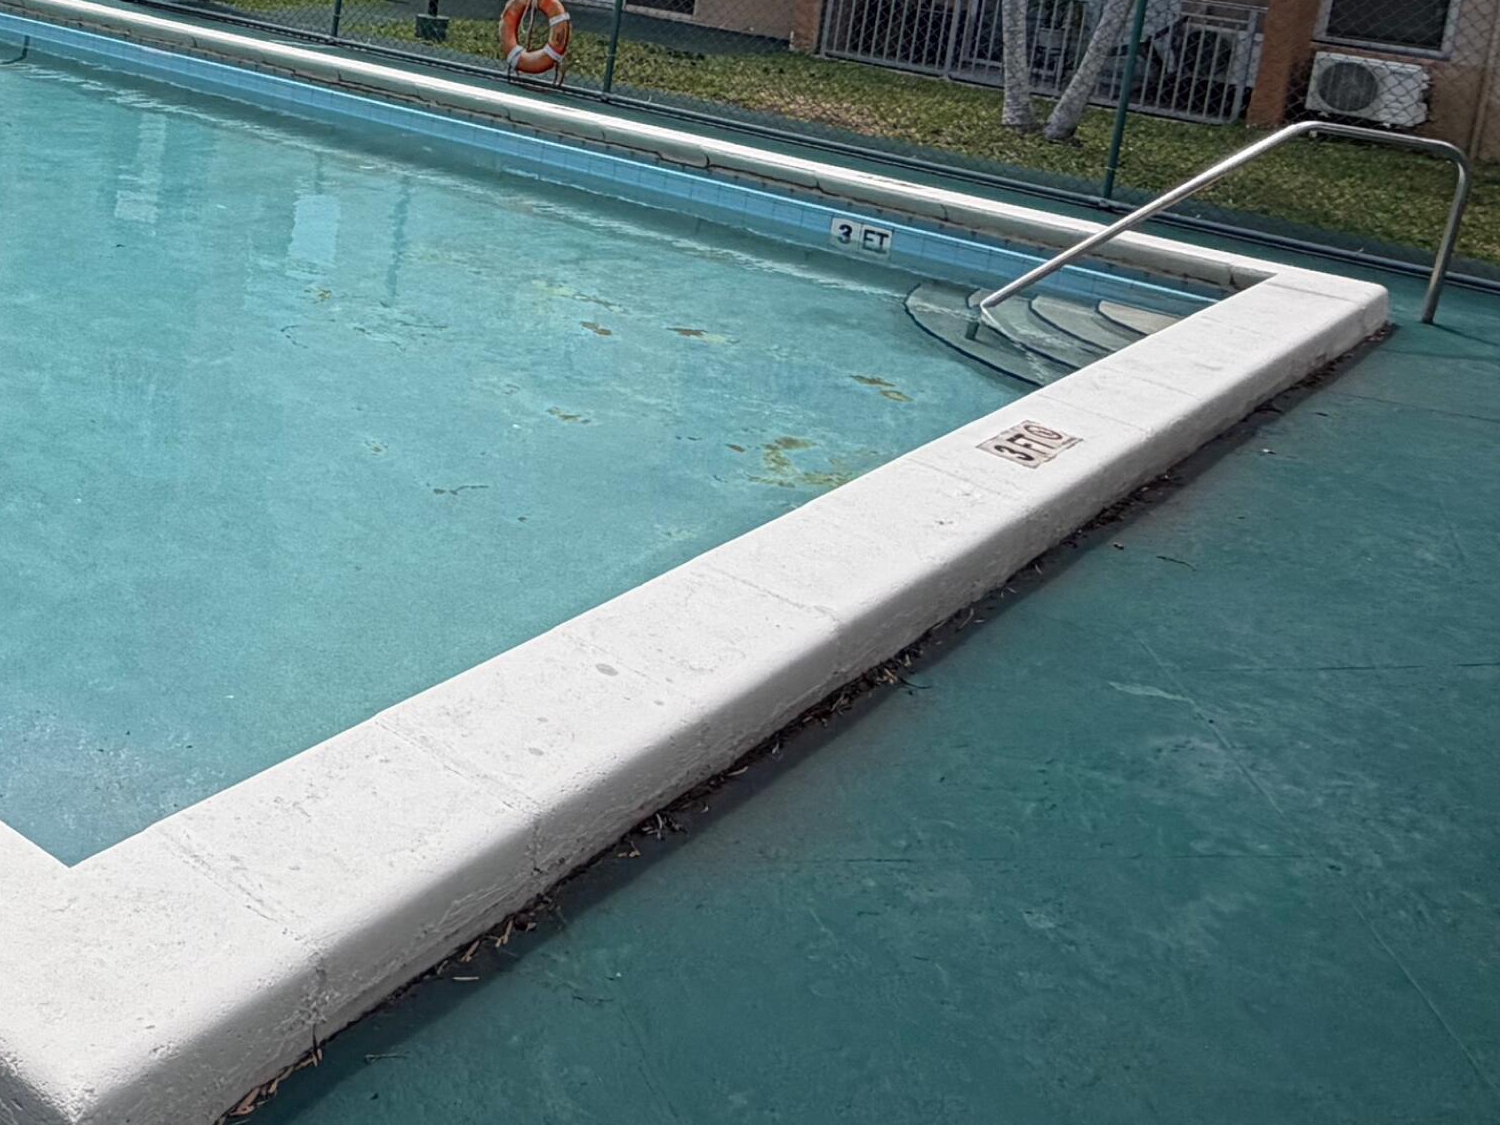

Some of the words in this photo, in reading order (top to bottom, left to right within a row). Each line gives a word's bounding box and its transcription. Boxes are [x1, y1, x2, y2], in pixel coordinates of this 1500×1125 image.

[838, 224, 852, 245] 3
[862, 229, 889, 254] FT
[994, 445, 1035, 461] 3
[1006, 433, 1056, 454] FT
